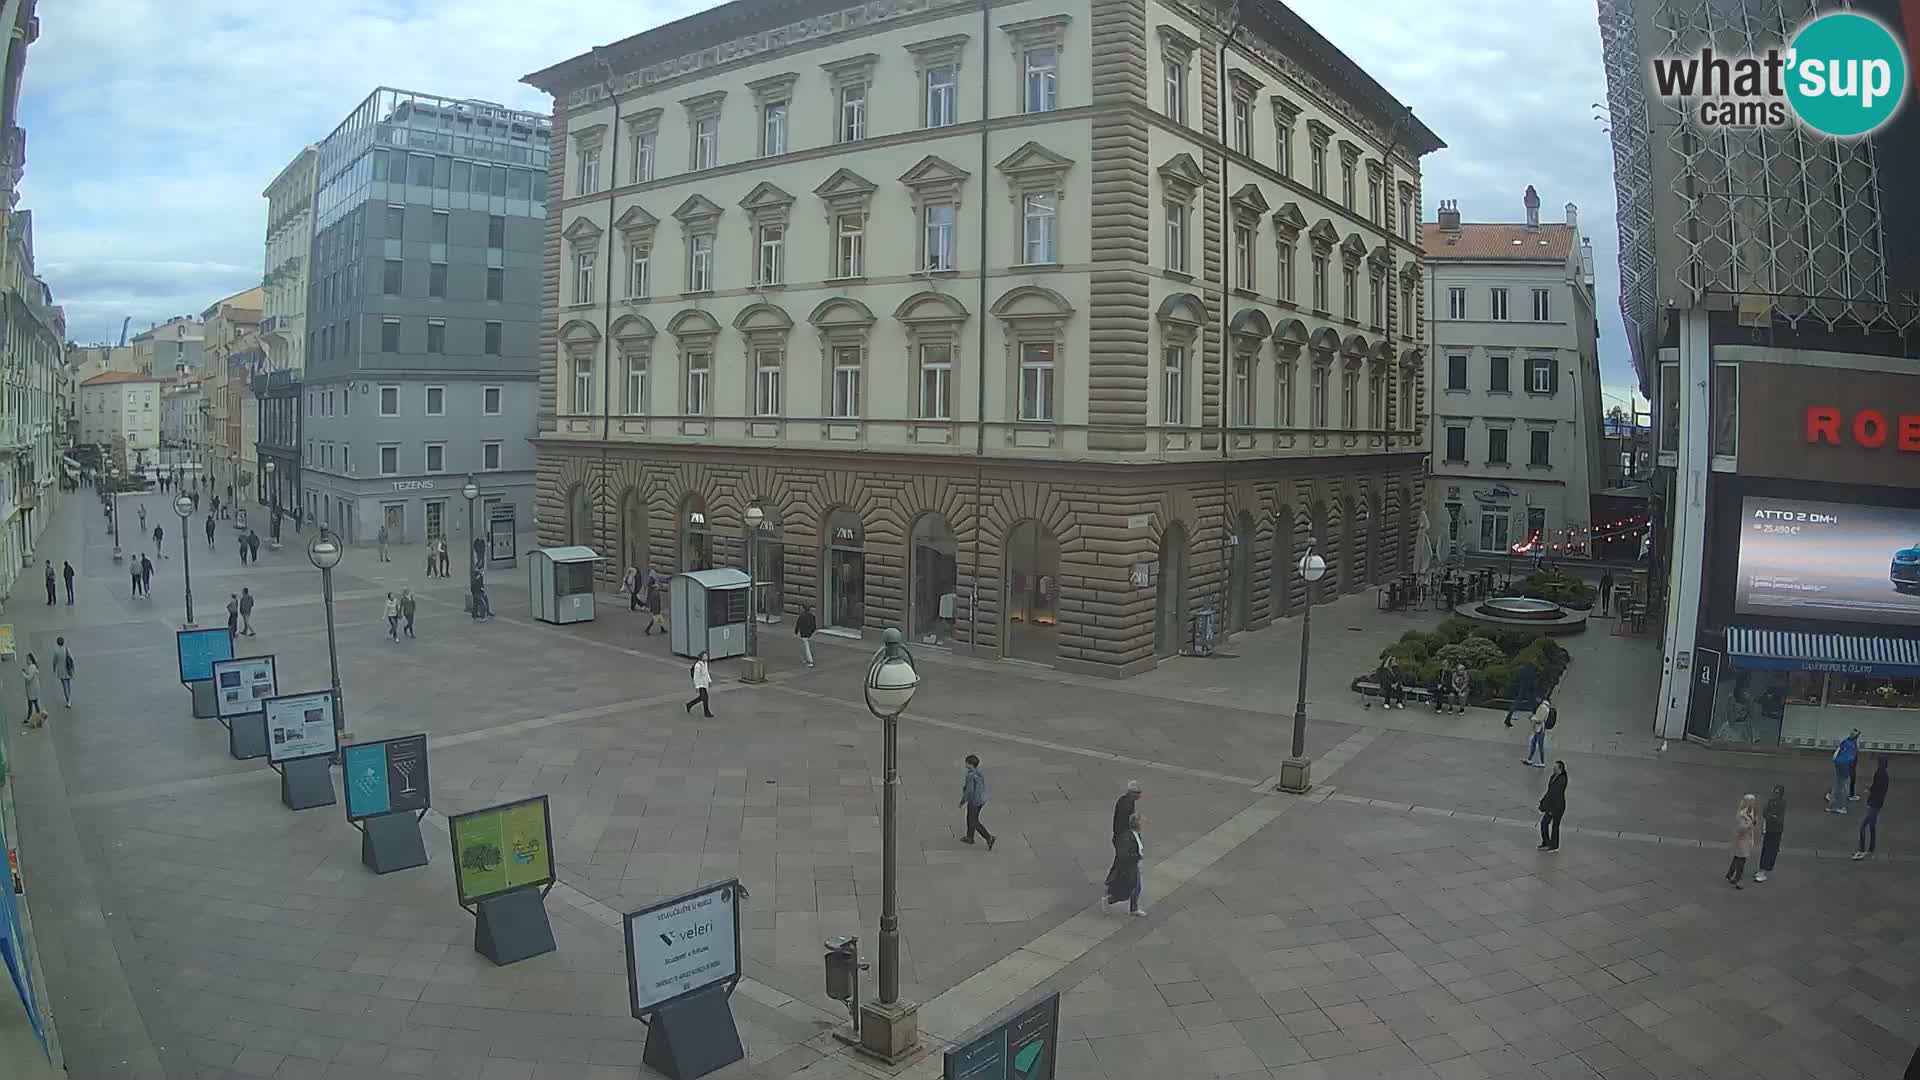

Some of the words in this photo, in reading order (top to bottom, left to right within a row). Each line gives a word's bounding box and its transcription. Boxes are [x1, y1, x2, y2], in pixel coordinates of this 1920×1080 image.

[392, 480, 434, 490] TEZENIS
[1754, 510, 1793, 521] ATTO
[1797, 513, 1806, 521] 2
[679, 920, 713, 941] veleri
